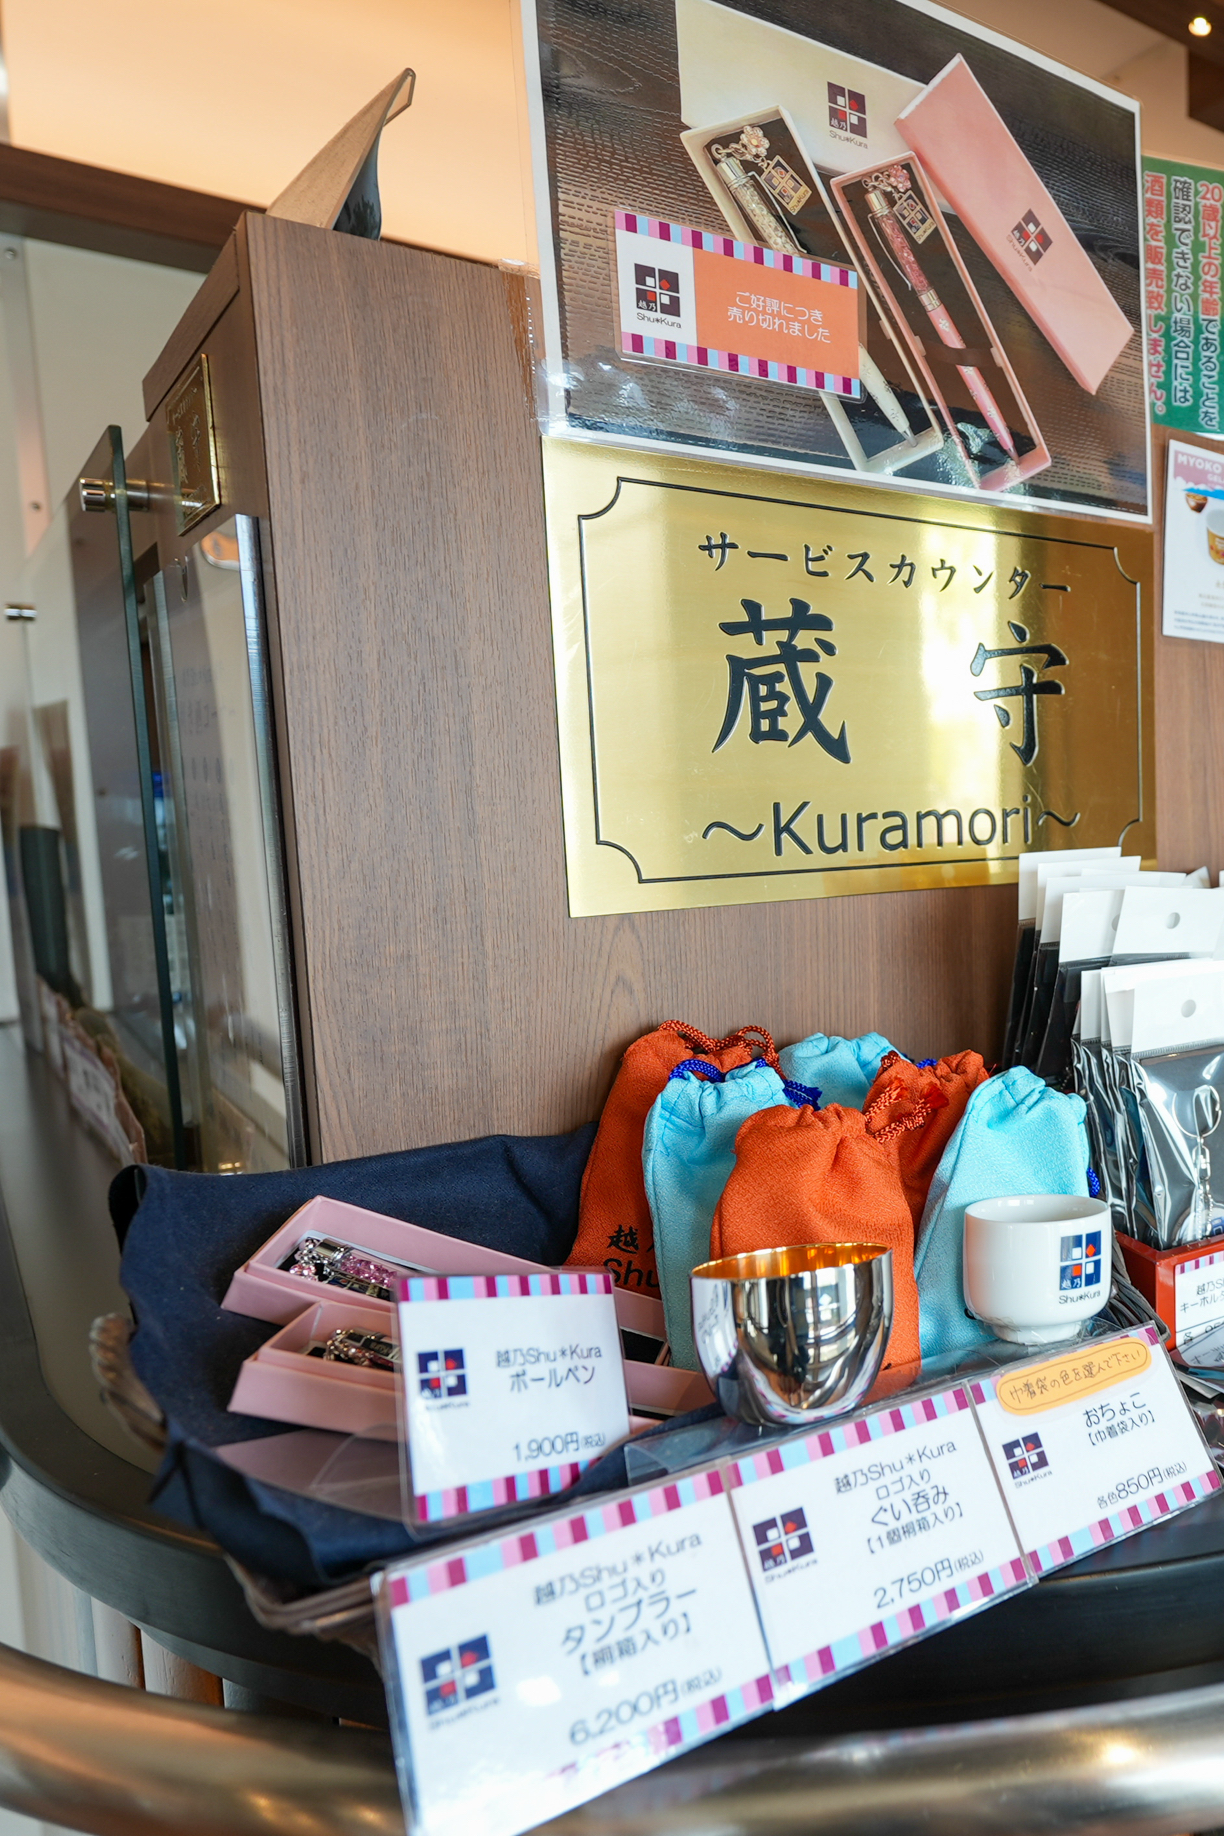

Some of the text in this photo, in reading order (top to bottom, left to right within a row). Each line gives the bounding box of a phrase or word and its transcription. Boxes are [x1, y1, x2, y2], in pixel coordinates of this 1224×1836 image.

[736, 291, 823, 325] ご好評につき
[1171, 177, 1194, 406] 確認できない場合には
[1199, 182, 1223, 428] 20歳以上の年齢であることを
[727, 306, 831, 343] 売り切れました
[1177, 453, 1222, 475] MYOKO
[698, 531, 1071, 600] サービスカウンター
[711, 598, 1069, 767] 蔵 守
[510, 1365, 596, 1393] ボールペン
[1082, 1392, 1147, 1428] おちょこ
[875, 1468, 931, 1501] ロゴ入り
[871, 1485, 949, 1527] ぐい呑み
[584, 1568, 666, 1613] ロゴ入り
